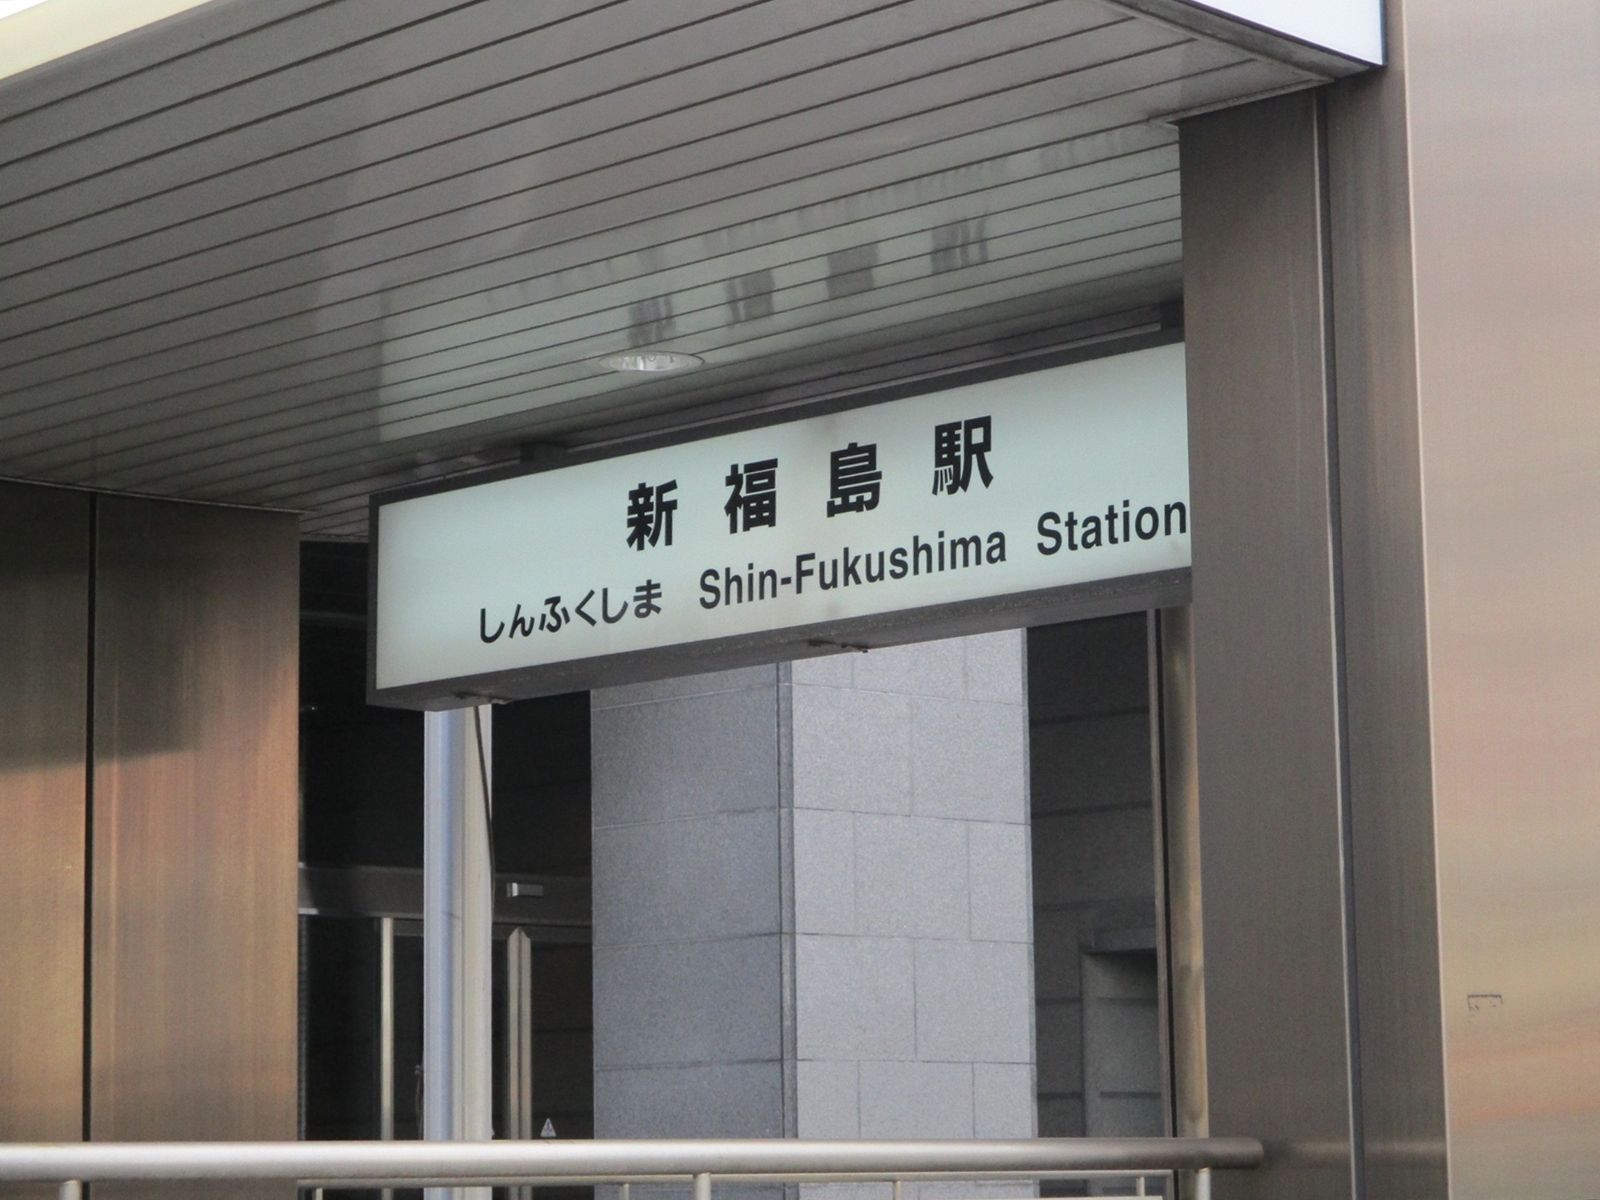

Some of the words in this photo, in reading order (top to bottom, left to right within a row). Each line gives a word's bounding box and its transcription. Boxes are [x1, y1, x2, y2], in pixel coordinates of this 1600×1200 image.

[626, 415, 994, 552] 新福島駅
[699, 530, 1007, 610] Shin-Fukushima
[1037, 499, 1187, 556] Station
[480, 579, 662, 644] しんふくしま
